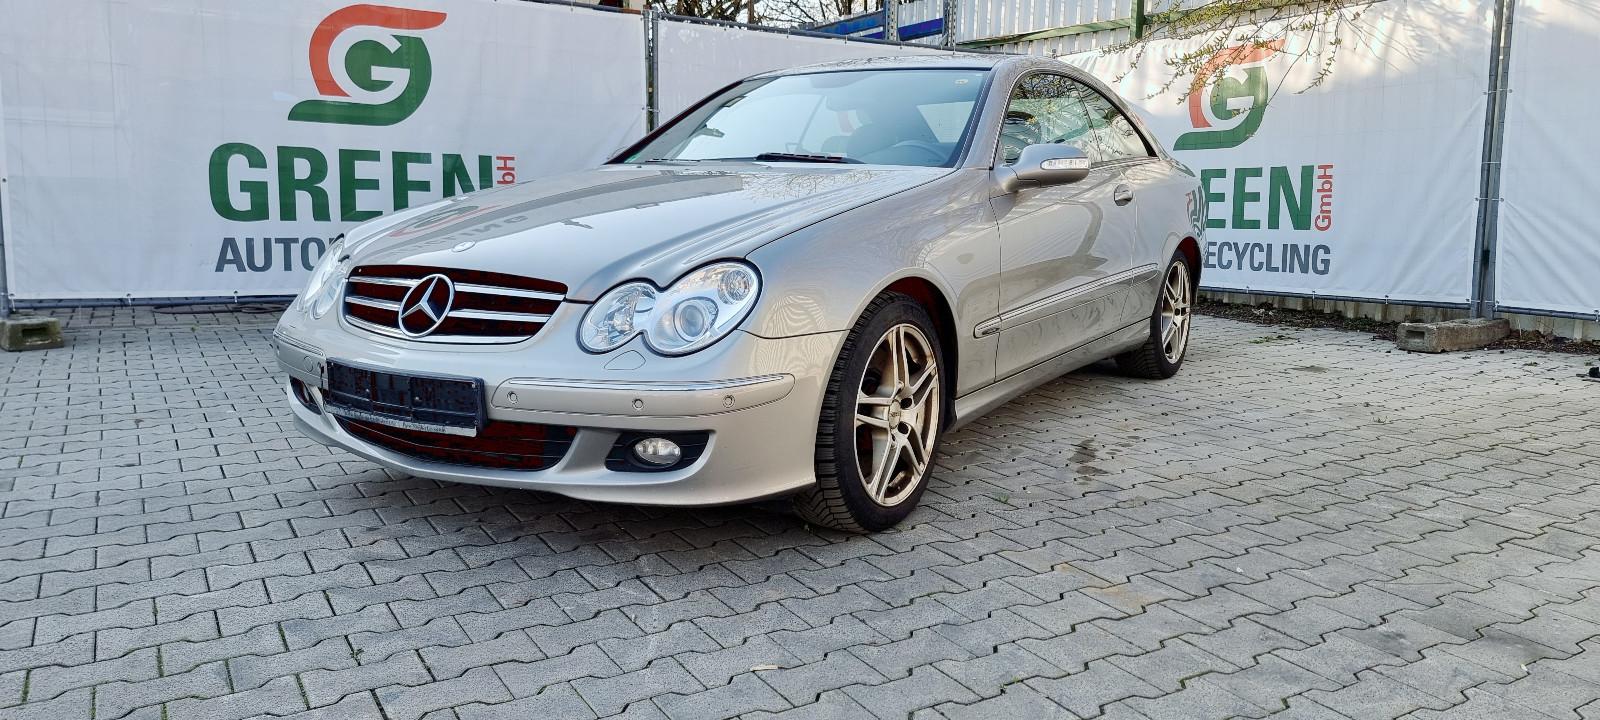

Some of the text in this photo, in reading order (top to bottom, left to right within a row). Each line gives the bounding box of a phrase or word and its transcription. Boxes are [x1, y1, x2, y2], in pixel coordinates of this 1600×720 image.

[495, 156, 516, 185] bH
[1200, 165, 1315, 231] EEN
[1314, 164, 1334, 232] GmbH
[214, 237, 335, 273] AUTO
[1203, 241, 1331, 276] ECYCLING
